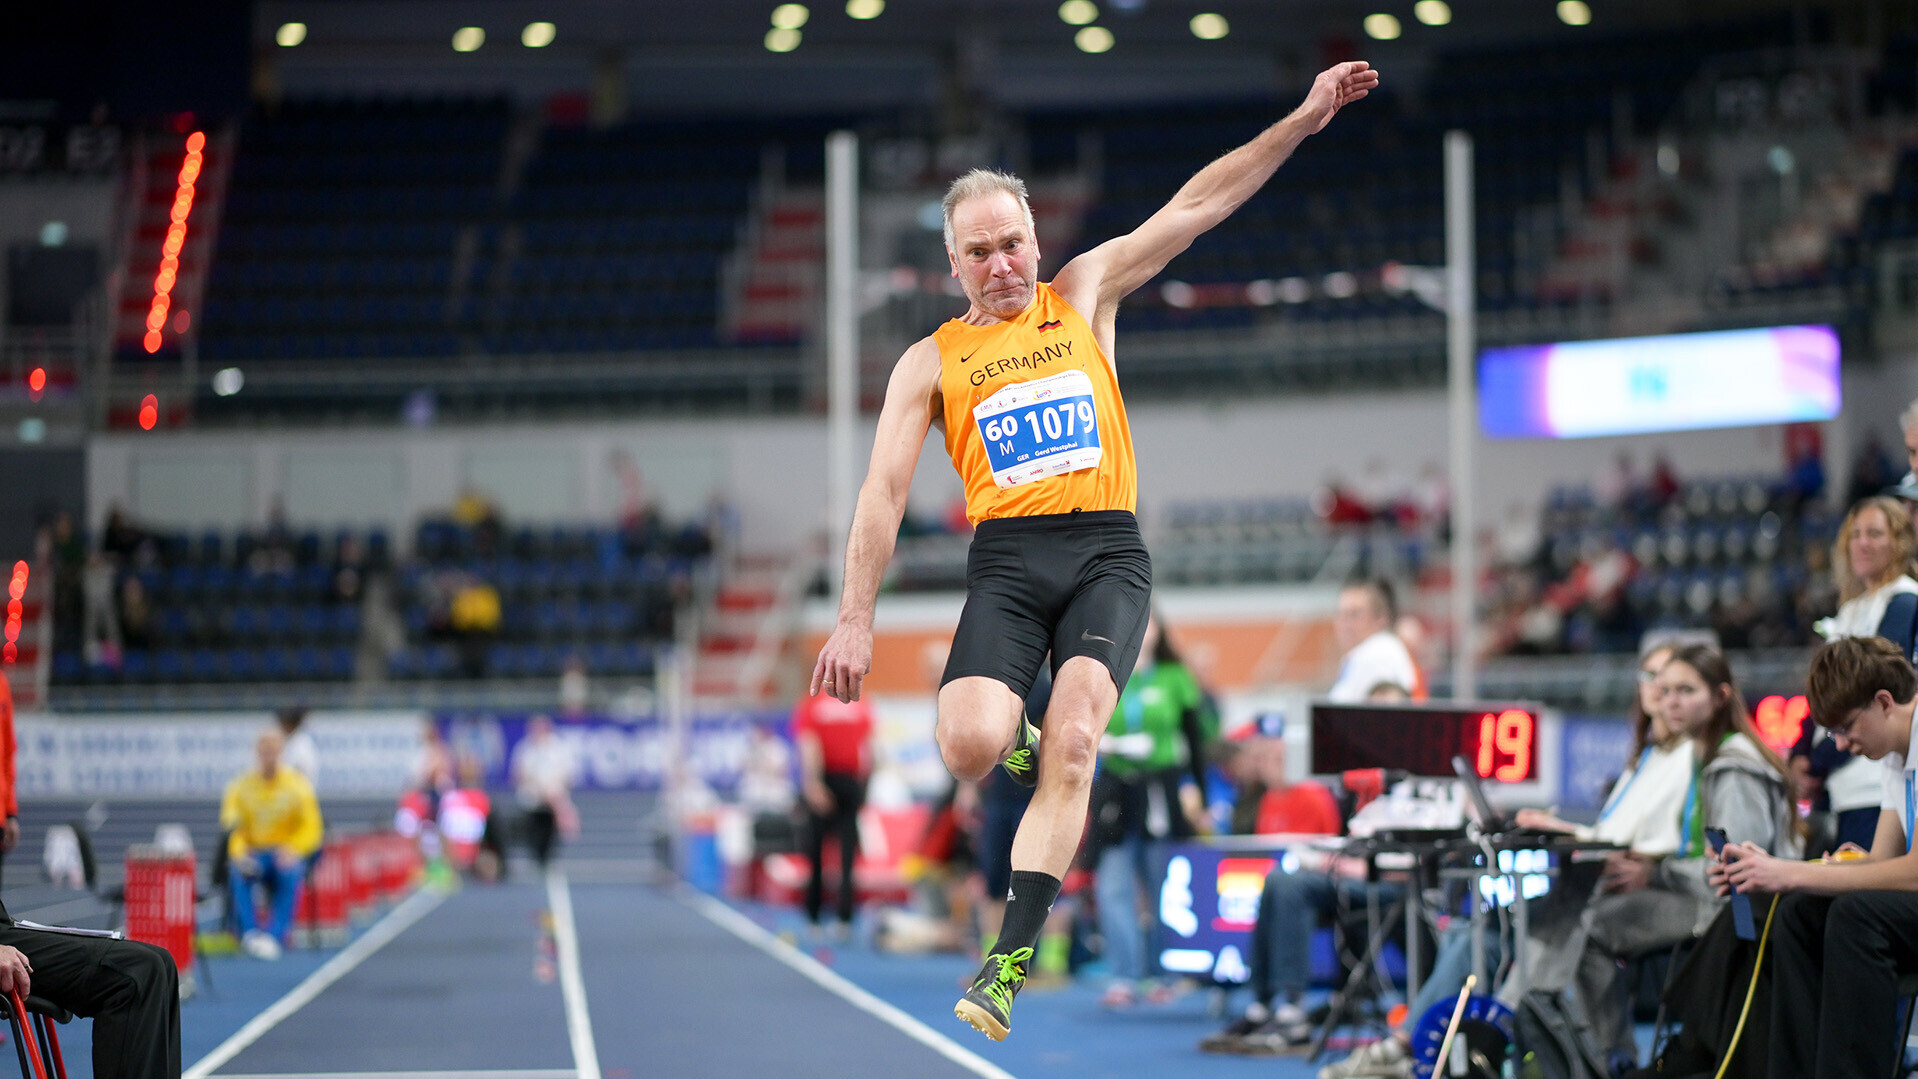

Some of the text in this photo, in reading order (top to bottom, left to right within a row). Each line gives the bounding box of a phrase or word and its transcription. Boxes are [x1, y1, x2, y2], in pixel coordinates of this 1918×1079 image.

[970, 341, 1072, 387] GERMANY
[985, 400, 1095, 444] 60 1079
[999, 440, 1015, 456] M
[1017, 441, 1078, 462] GER Gerd Westphal
[1476, 709, 1533, 783] 19
